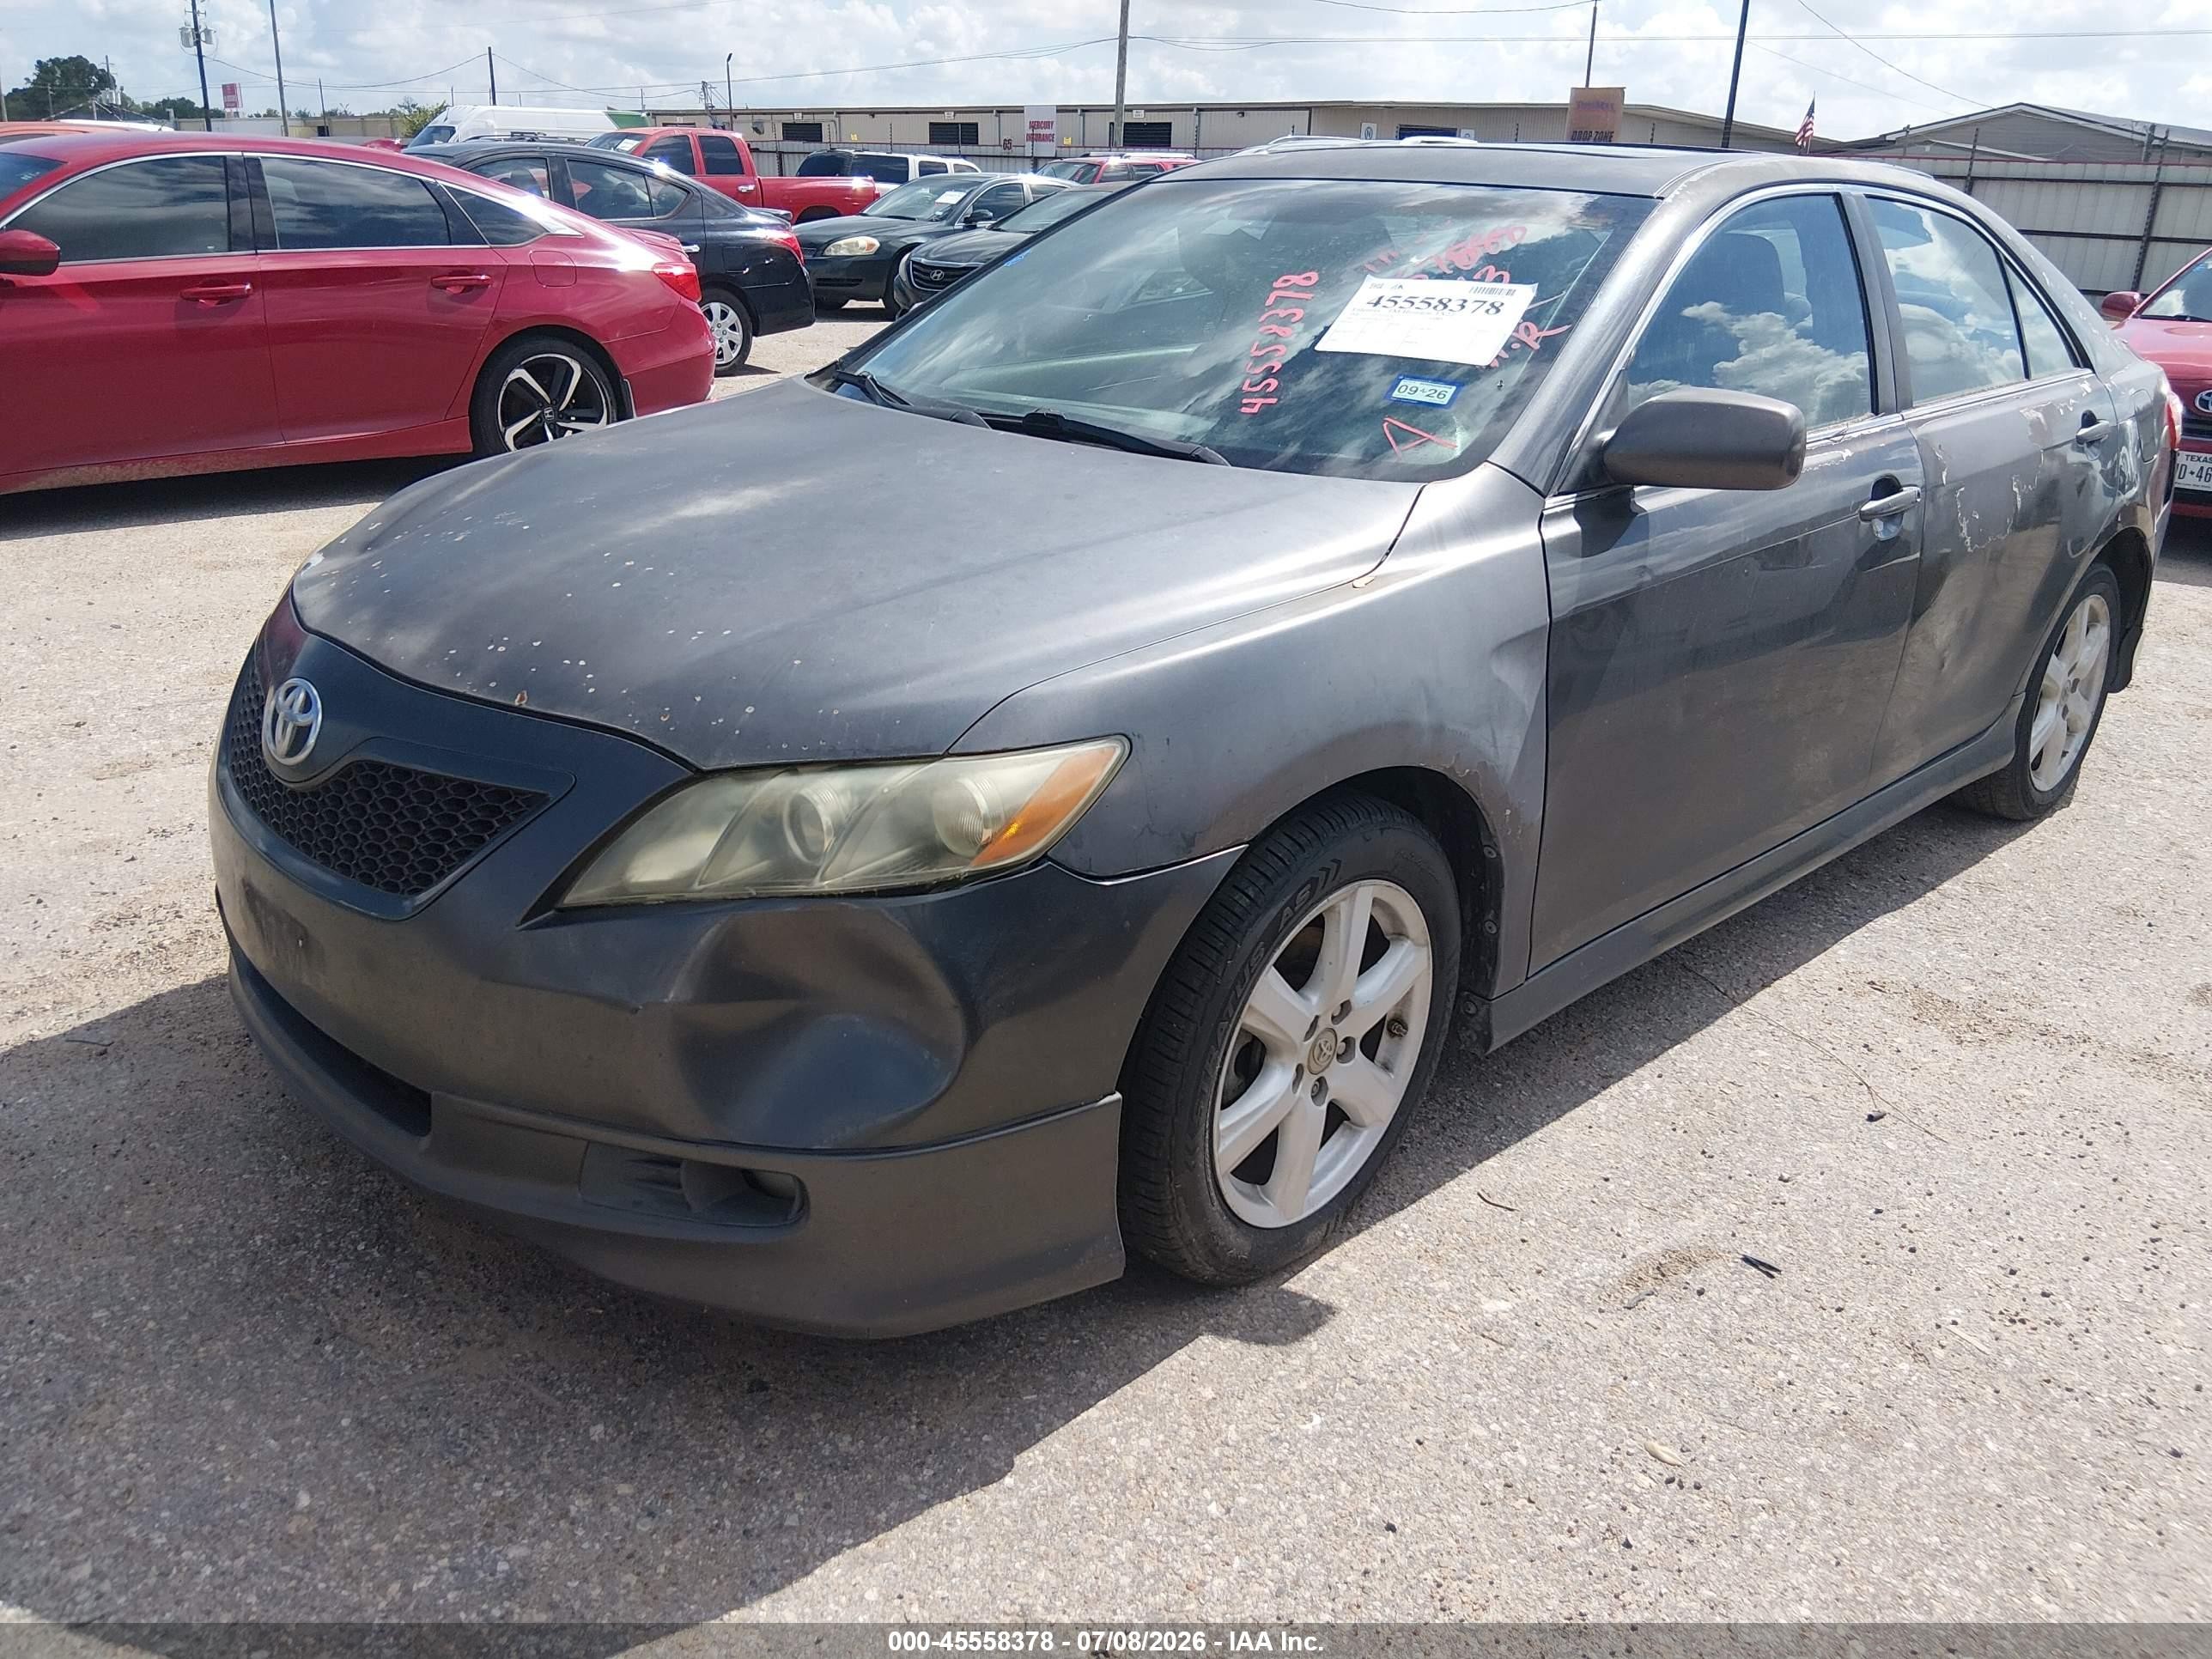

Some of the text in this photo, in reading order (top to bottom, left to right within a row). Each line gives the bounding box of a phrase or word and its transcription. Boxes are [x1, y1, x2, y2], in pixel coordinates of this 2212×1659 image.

[1029, 120, 1054, 130] MERCURY
[1571, 130, 1614, 142] DROP ZONE
[1003, 138, 1012, 151] 65
[1367, 295, 1505, 316] 45558378
[1239, 270, 1320, 415] 45558378
